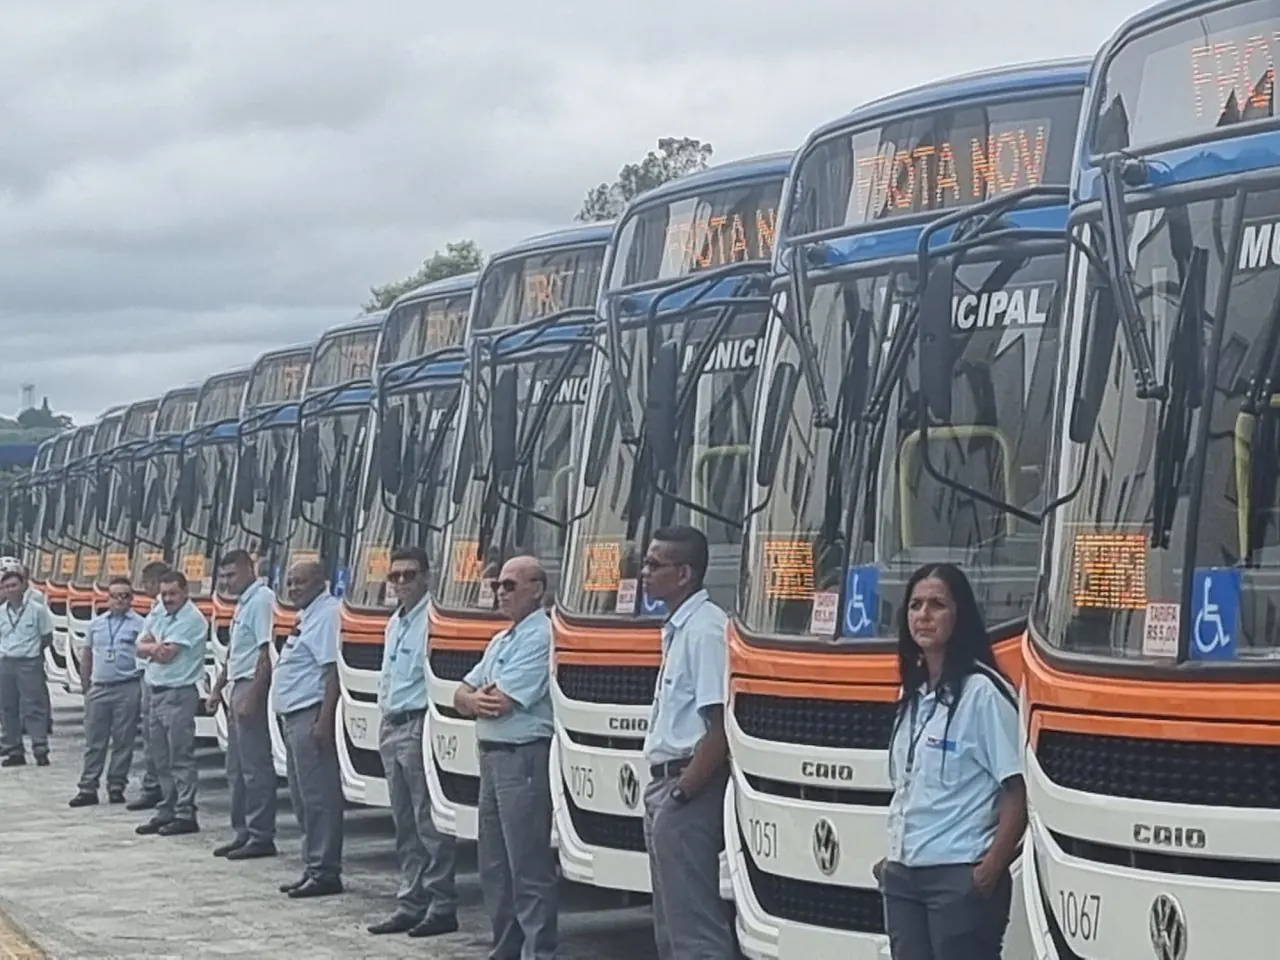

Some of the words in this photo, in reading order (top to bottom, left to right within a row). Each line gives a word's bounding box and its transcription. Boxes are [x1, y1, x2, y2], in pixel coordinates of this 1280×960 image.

[609, 717, 649, 731] CAIO
[802, 761, 853, 781] CAIO
[749, 818, 778, 859] 1051
[1133, 823, 1206, 849] CAIO
[1059, 890, 1101, 942] 1067
